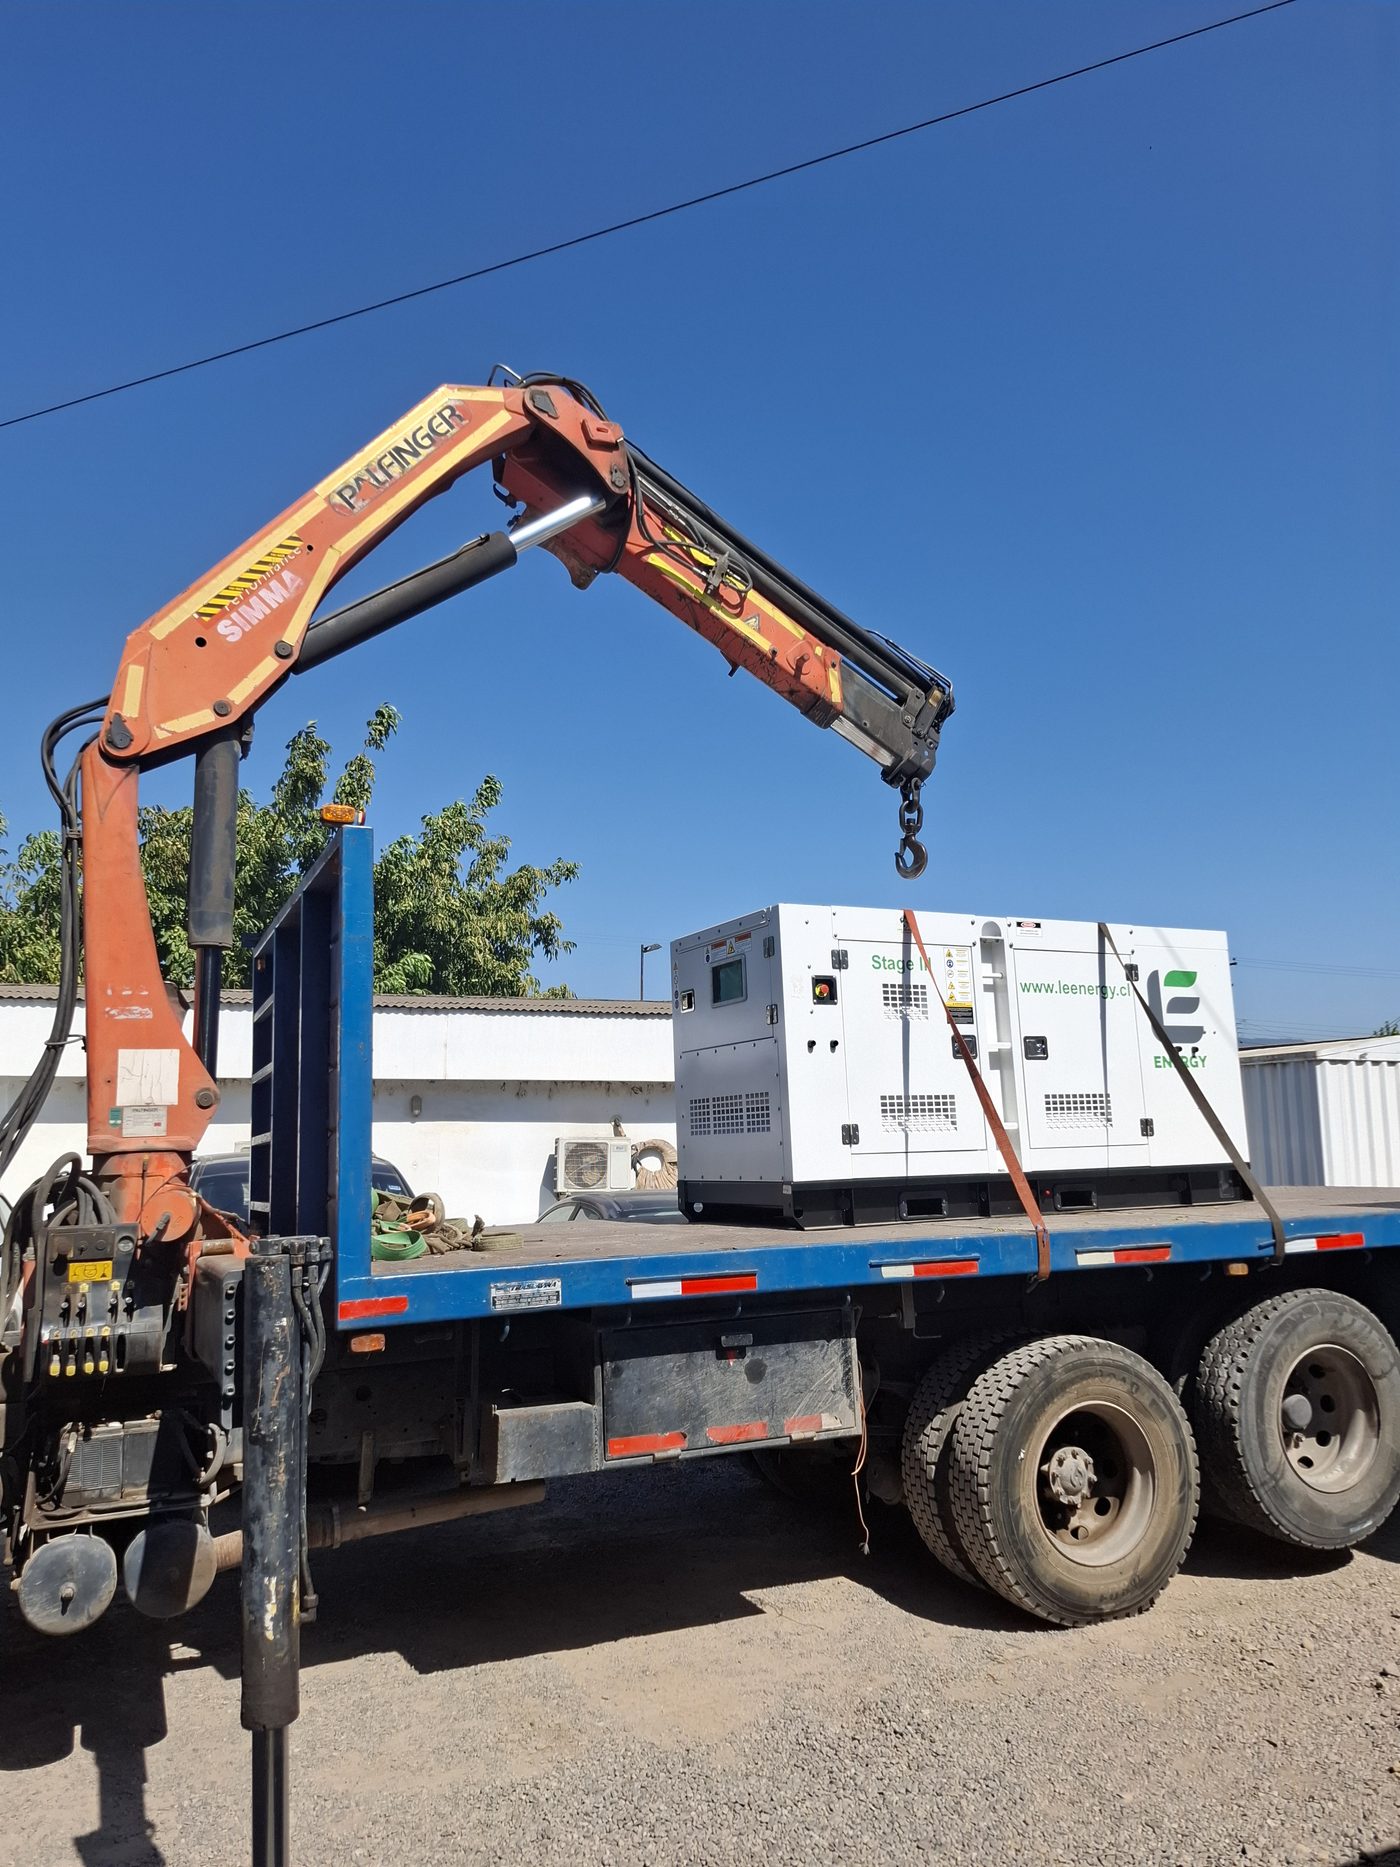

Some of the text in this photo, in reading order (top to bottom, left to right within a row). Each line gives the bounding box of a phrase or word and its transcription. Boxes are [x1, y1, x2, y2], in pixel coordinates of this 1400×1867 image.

[336, 404, 465, 510] PALFINGER
[216, 569, 304, 643] SIMMA
[871, 954, 915, 975] Stage
[1019, 979, 1132, 1000] www.leenergy.cl
[1153, 1055, 1208, 1069] ENRGY
